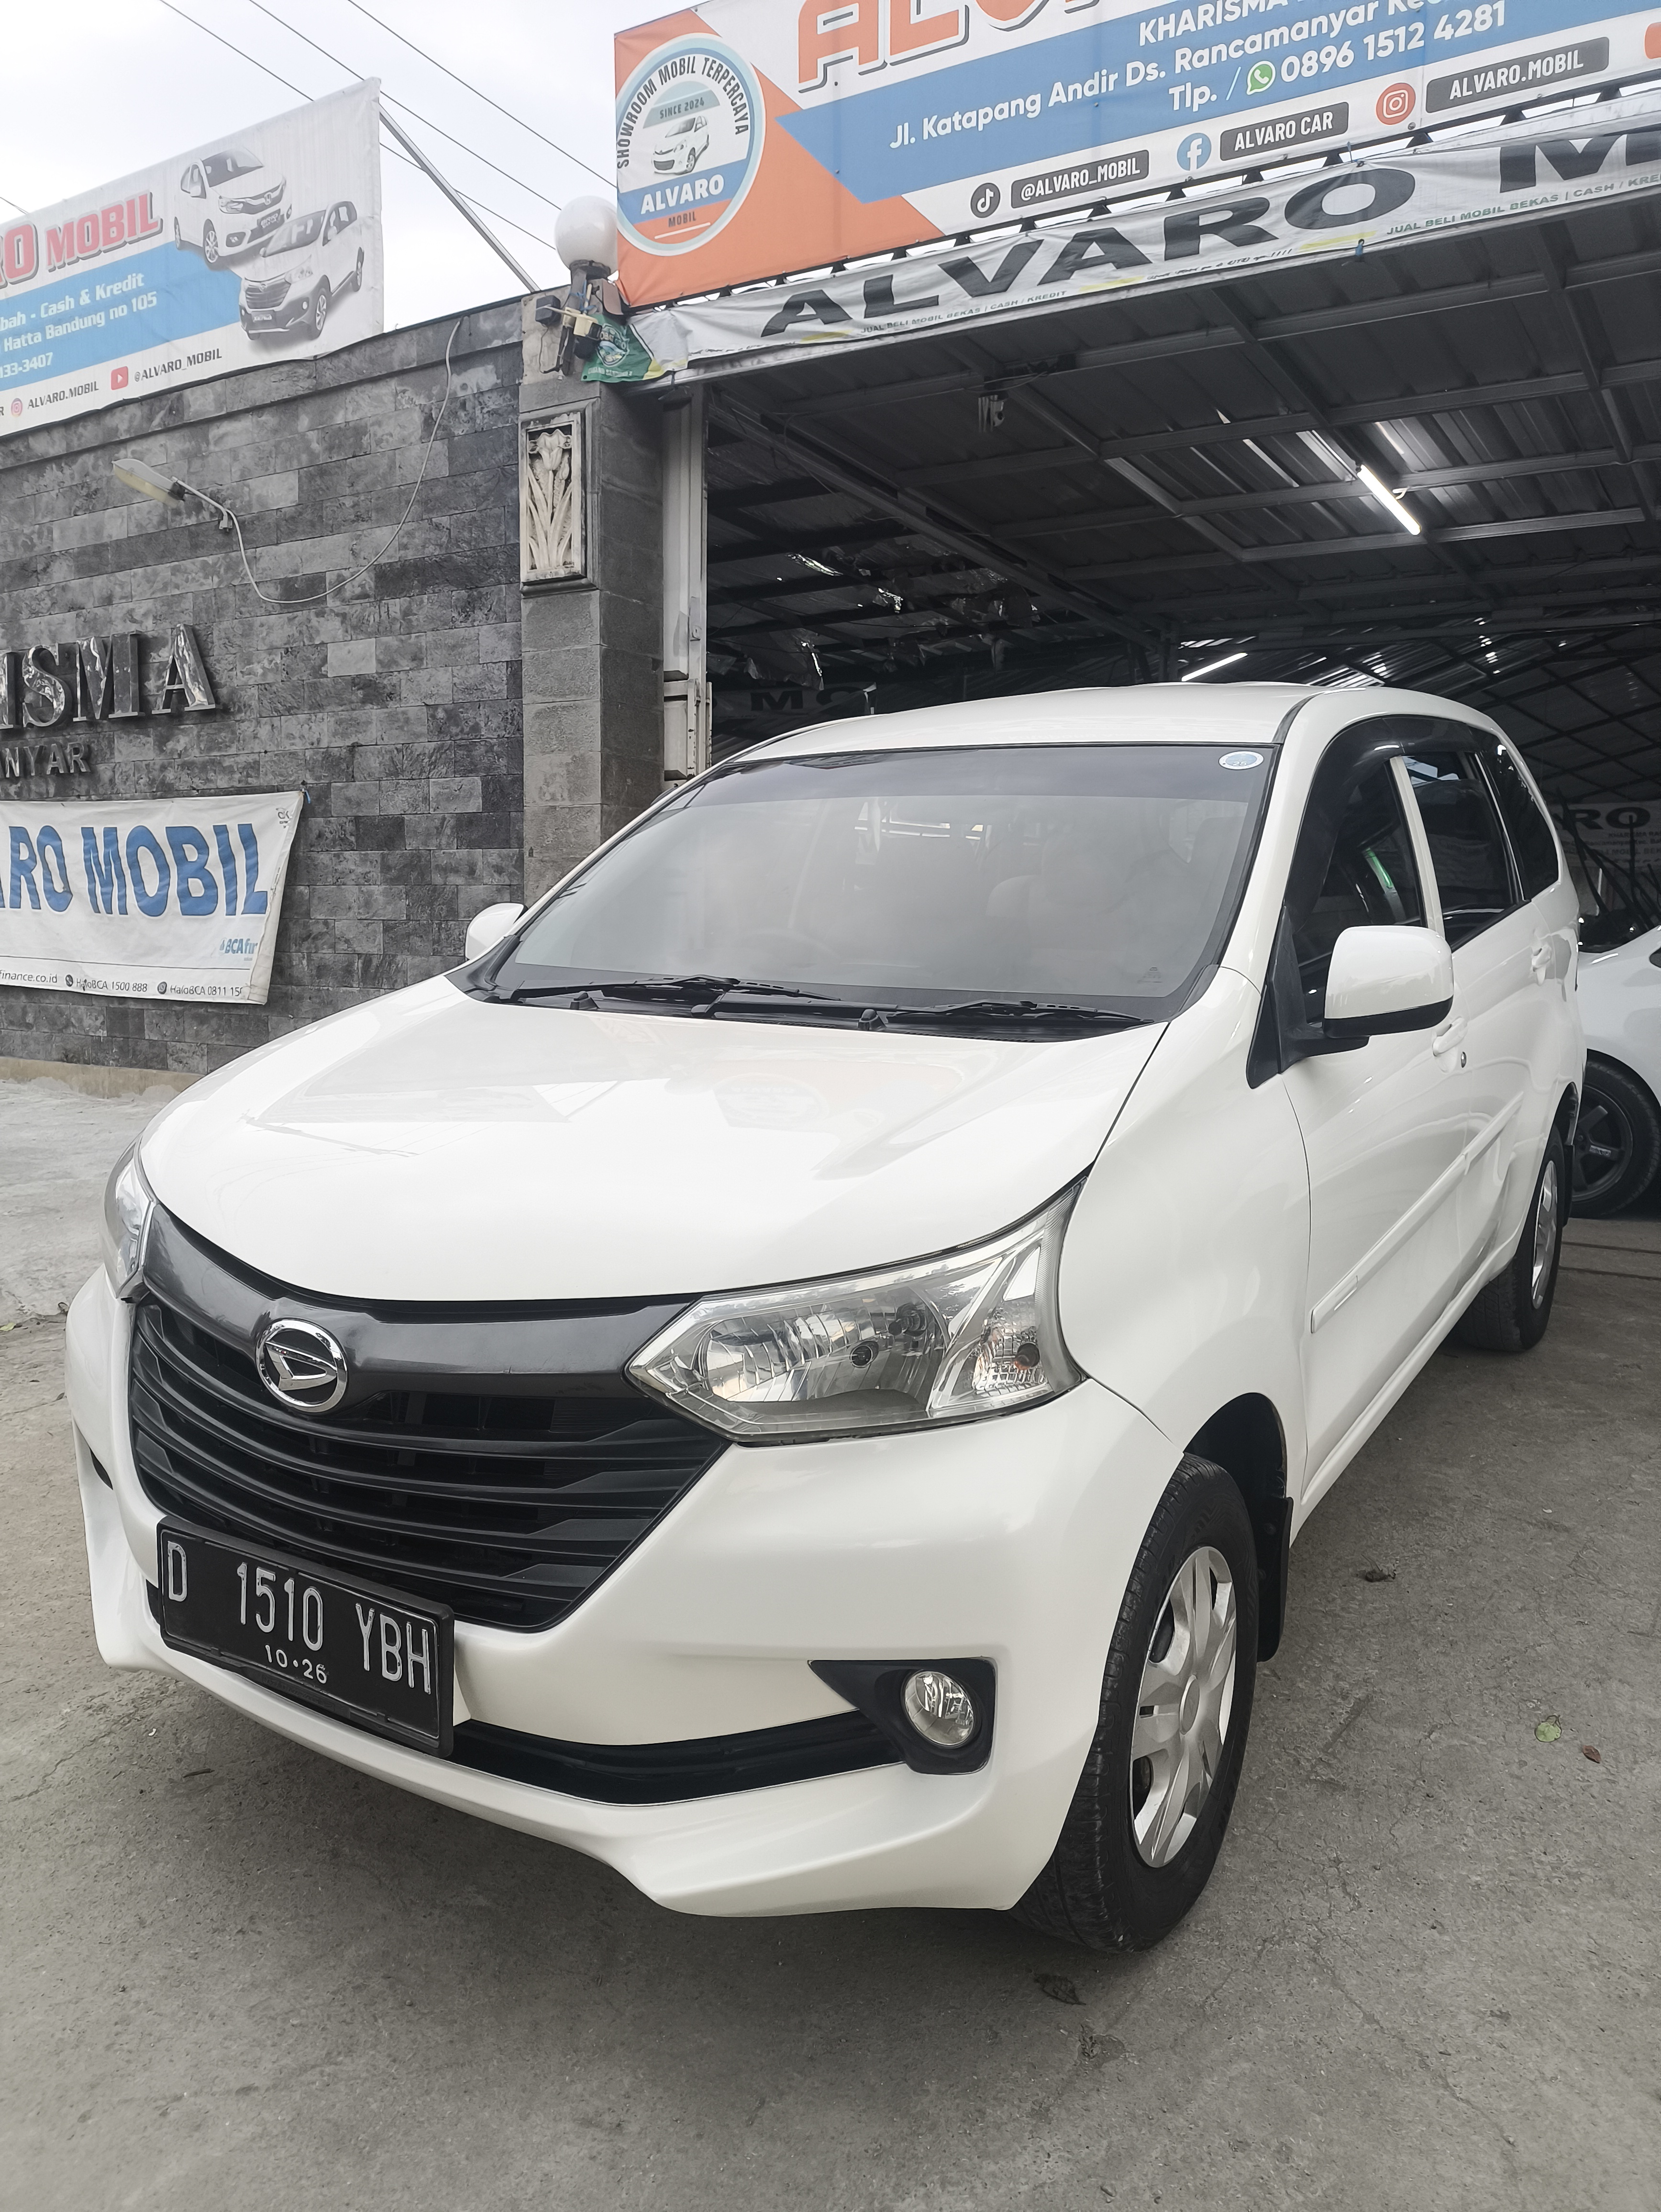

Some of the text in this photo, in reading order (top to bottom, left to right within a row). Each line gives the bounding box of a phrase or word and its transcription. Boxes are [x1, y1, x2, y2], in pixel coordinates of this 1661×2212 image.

[889, 123, 916, 149] Jl.
[922, 93, 1042, 140] Katapang
[1048, 69, 1118, 107] Andir
[1125, 60, 1166, 88] Ds.
[1174, 1, 1374, 74] Rancamanyar
[1168, 84, 1218, 112] Tlp.
[1281, 41, 1354, 82] 0896
[1363, 23, 1424, 61] 1512
[1433, 3, 1506, 40] 4281
[1449, 50, 1584, 100] ALVARO.MOBIL
[617, 56, 749, 169] SHOWROOM MOBIL TERPERCAYA
[660, 105, 682, 119] SINCE
[1234, 112, 1333, 152] ALVARO CAR
[641, 175, 725, 215] ALVARO
[1021, 158, 1141, 201] @ALVARO_MOBIL
[668, 211, 697, 228] MOBIL
[1387, 222, 1421, 235] JUAL
[1425, 215, 1456, 227] BELI
[1460, 206, 1505, 220] MOBIL
[1510, 194, 1559, 211] BEKAS
[1573, 182, 1615, 197] CASH
[1628, 173, 1661, 187] KRE
[46, 192, 163, 272] MOBIL
[761, 167, 1416, 338] ALVARO
[41, 295, 75, 318] Cash
[79, 289, 91, 306] &
[95, 273, 144, 300] Kredit
[861, 324, 884, 333] JUAL
[886, 320, 908, 329] BELI
[912, 314, 943, 325] MOBIL
[947, 308, 980, 318] BEKAS
[990, 300, 1019, 310] CASH
[1027, 290, 1067, 302] KREDIT
[4, 291, 157, 352] Hatta Bandung no 105
[134, 348, 222, 382] @ALVARO_MOBIL
[27, 381, 99, 410] ALVARO.MOBIL
[2, 742, 89, 778] NYAR
[80, 823, 268, 917] MOBIL
[111, 981, 130, 992] 1500
[132, 983, 148, 992] 888
[208, 986, 227, 996] 0811
[167, 1540, 431, 1695] D 1510 YBH
